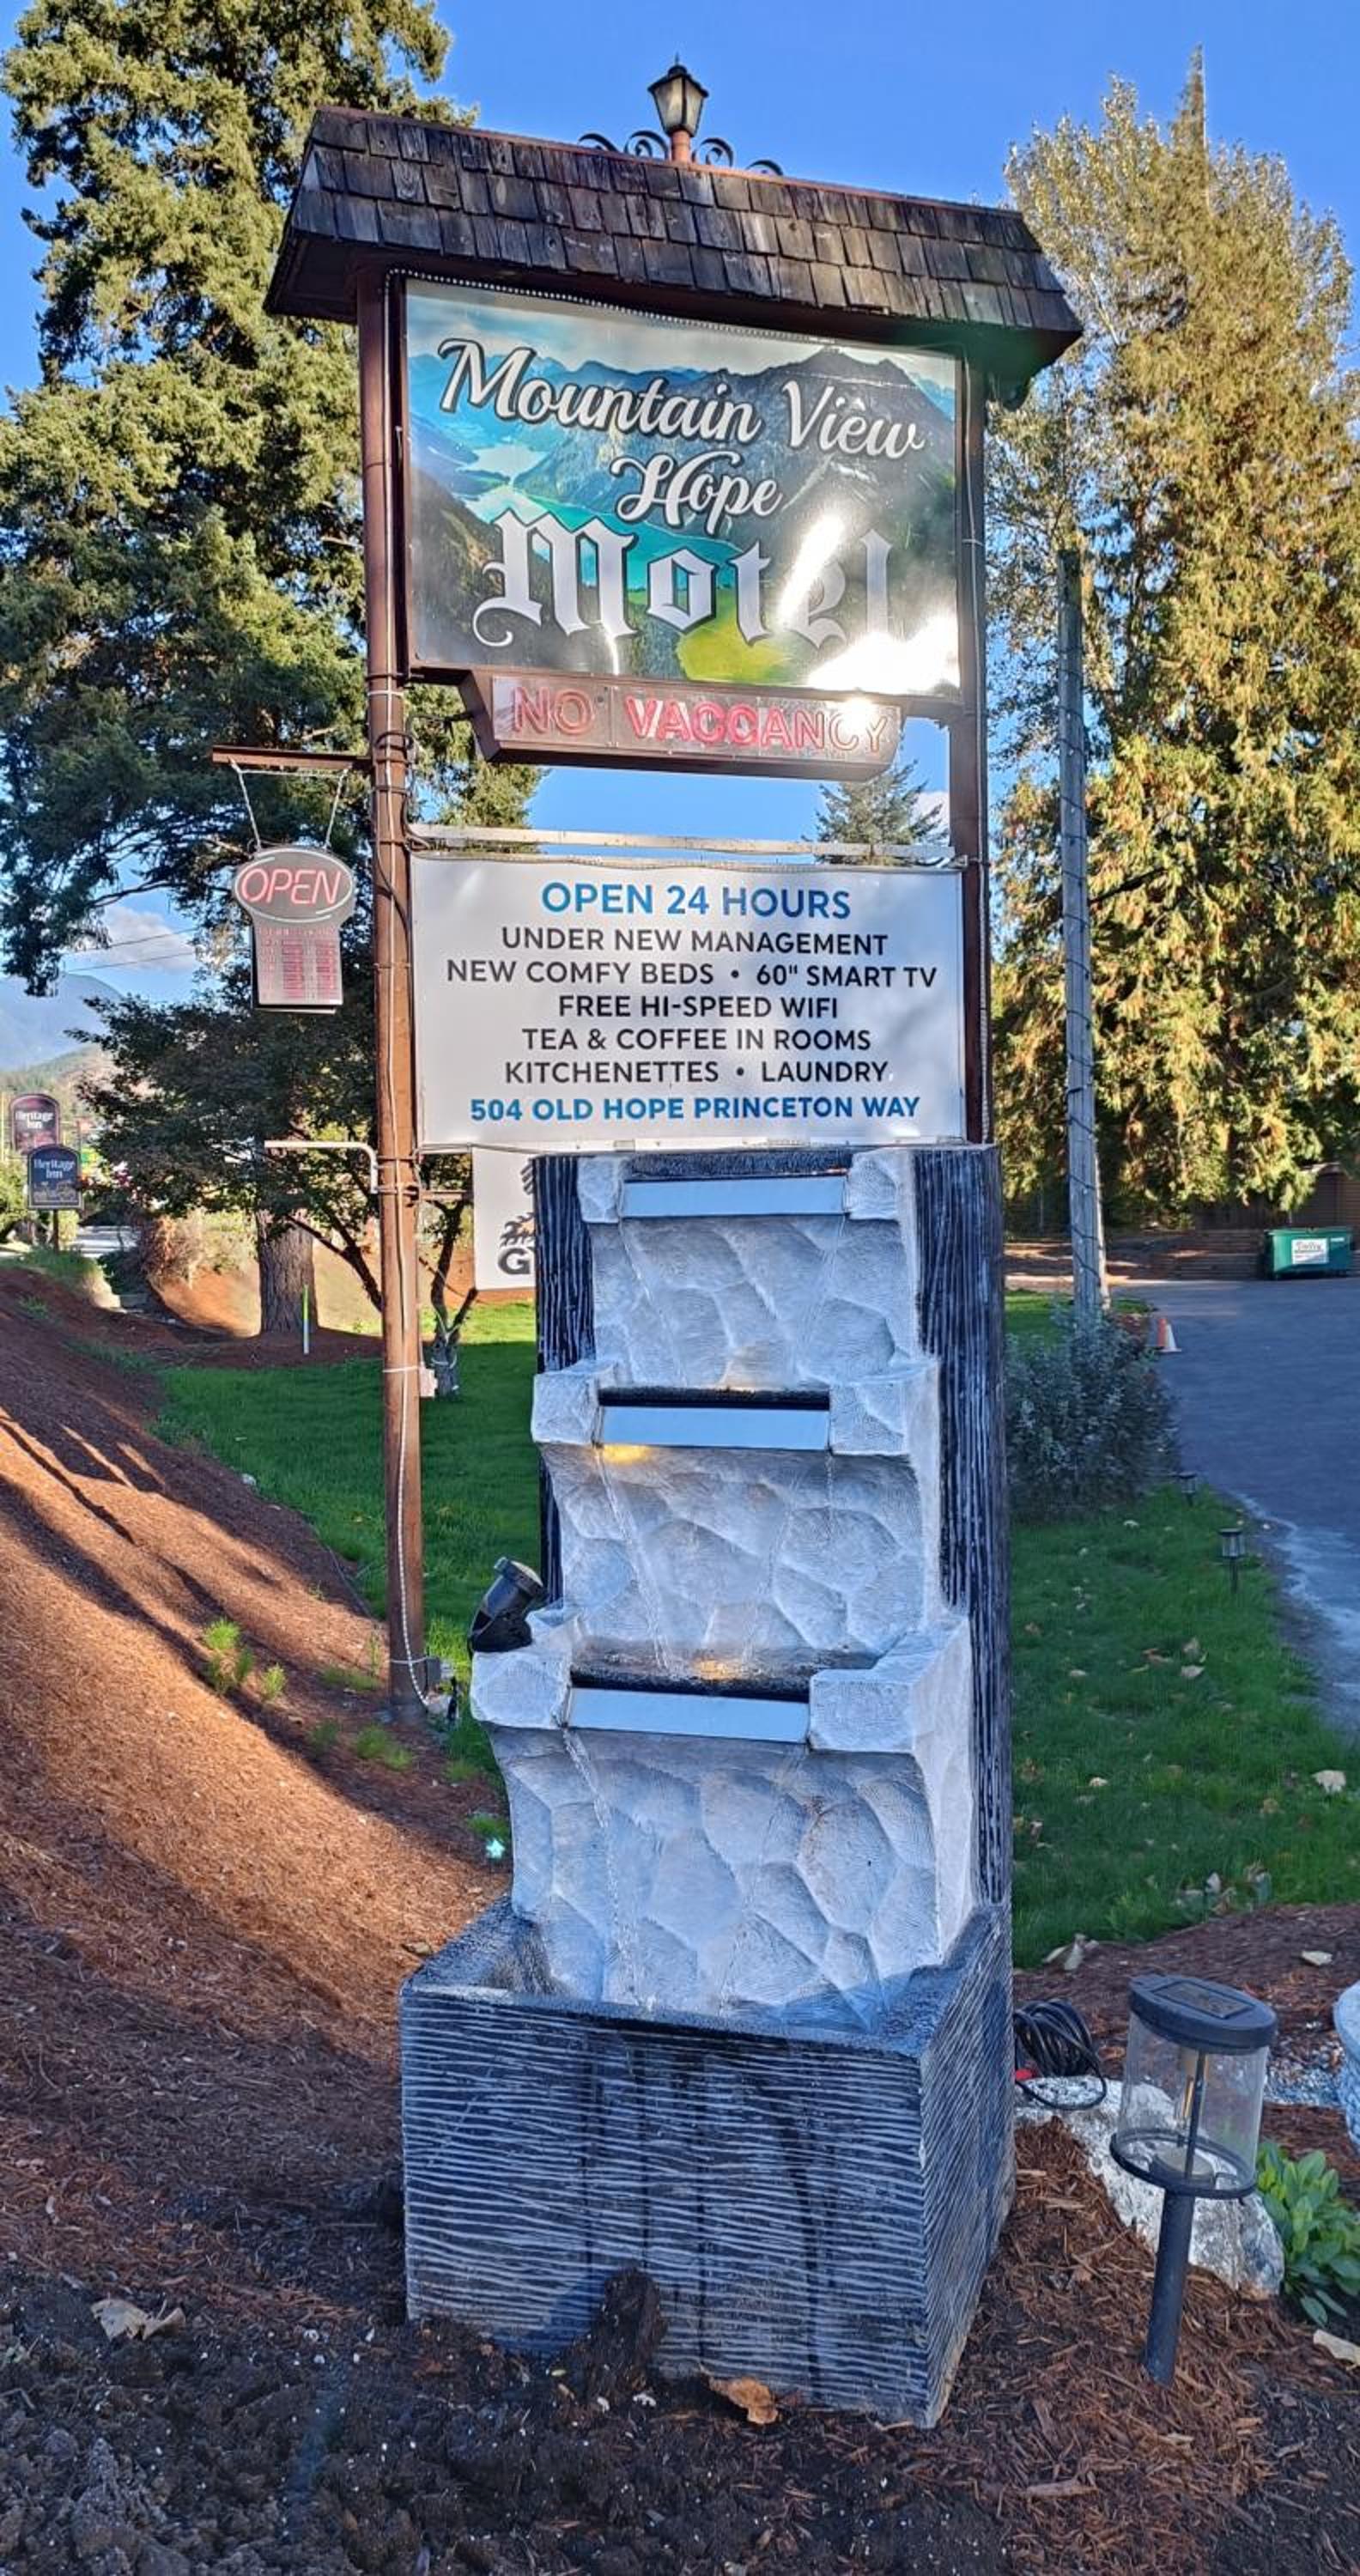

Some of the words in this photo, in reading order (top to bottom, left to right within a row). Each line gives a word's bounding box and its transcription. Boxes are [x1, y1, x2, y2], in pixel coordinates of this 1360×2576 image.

[438, 337, 762, 443] Mountain
[781, 380, 926, 459] View
[610, 450, 784, 536] Hope
[472, 507, 894, 649] Motel
[513, 687, 596, 737] NO
[241, 868, 341, 904] OPEN
[542, 882, 653, 914] OPEN
[666, 884, 710, 915] 24
[722, 886, 851, 920] HOURS
[501, 927, 604, 951] UNDER
[615, 929, 682, 951] NEW
[692, 931, 889, 956] MANAGEMENT
[446, 958, 517, 982] NEW
[525, 959, 632, 984] COMFY
[641, 962, 714, 985] BEDS
[756, 964, 798, 987] 60"
[807, 966, 896, 987] SMART
[903, 967, 938, 988] TV
[558, 994, 631, 1018] FREE
[641, 995, 773, 1018] HI-SPEED
[780, 996, 839, 1019] WIFI
[522, 1028, 579, 1050] TEA
[587, 1028, 606, 1050] &
[616, 1028, 727, 1050] COFFEE
[737, 1029, 764, 1050] IN
[774, 1029, 871, 1051] ROOMS
[505, 1061, 719, 1084] KITCHENETTES
[761, 1060, 889, 1083] LAUNDRY
[470, 1098, 523, 1121] 504
[531, 1099, 593, 1121] OLD
[602, 1098, 685, 1120] HOPE
[693, 1097, 854, 1119] PRINCETON
[861, 1097, 920, 1118] WAY
[33, 1158, 76, 1172] Heritage
[46, 1170, 63, 1179] Inn
